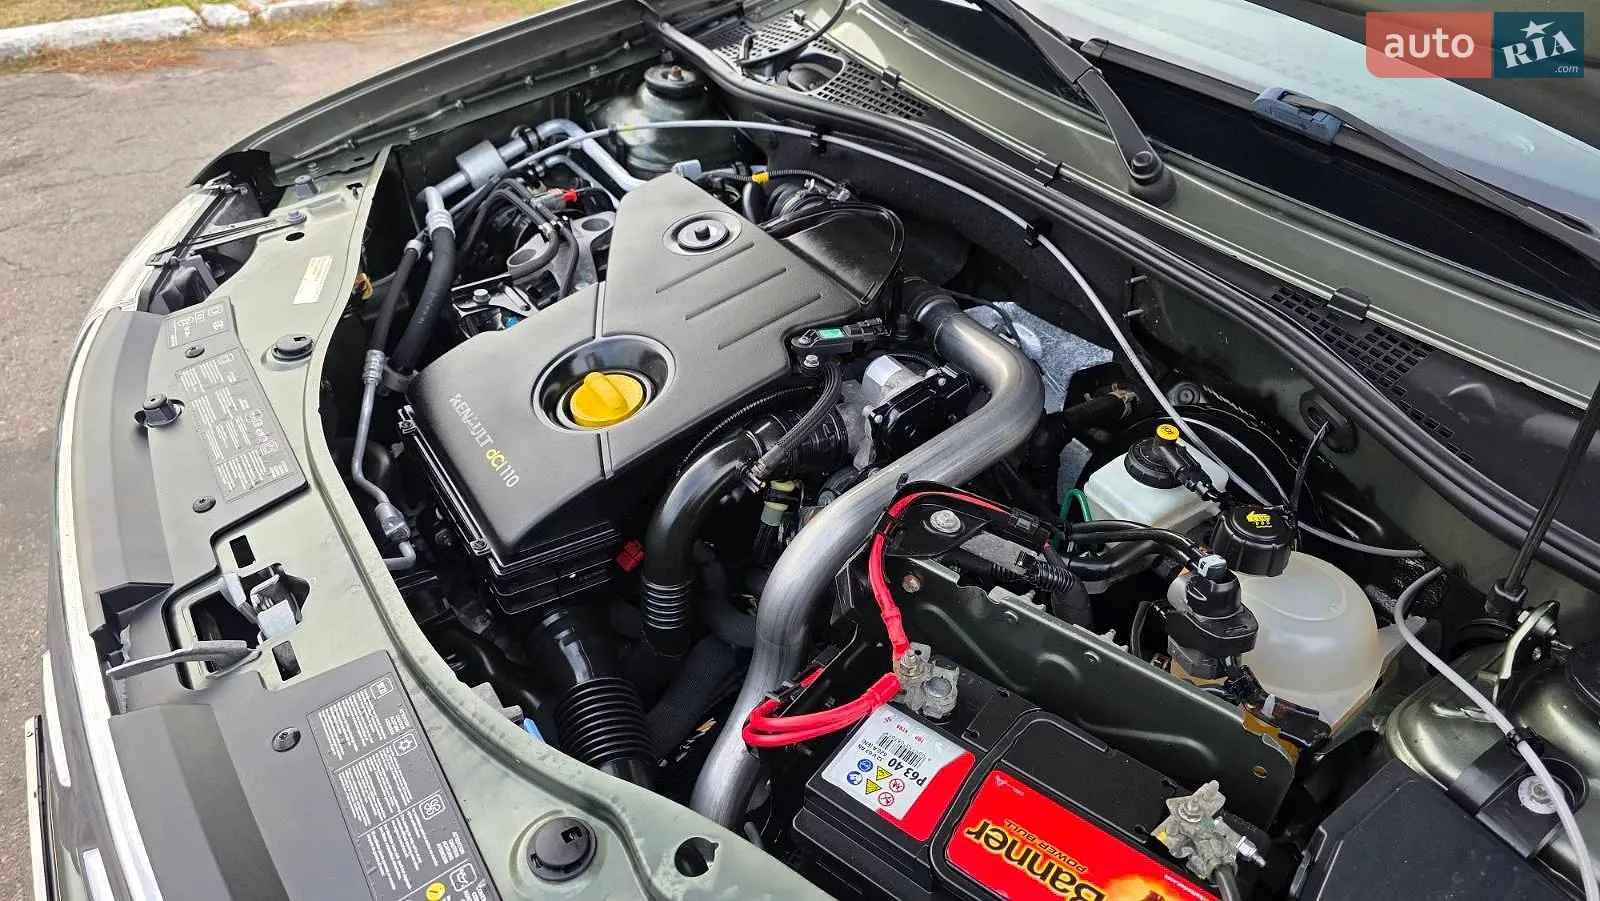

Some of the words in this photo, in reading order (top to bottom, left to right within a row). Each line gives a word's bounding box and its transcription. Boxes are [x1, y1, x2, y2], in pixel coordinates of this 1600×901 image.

[449, 393, 494, 448] RENAULT
[888, 758, 904, 771] 40
[903, 767, 928, 787] P63
[1006, 820, 1036, 842] BULL
[965, 820, 1106, 901] Banner
[1038, 841, 1087, 873] POWER
